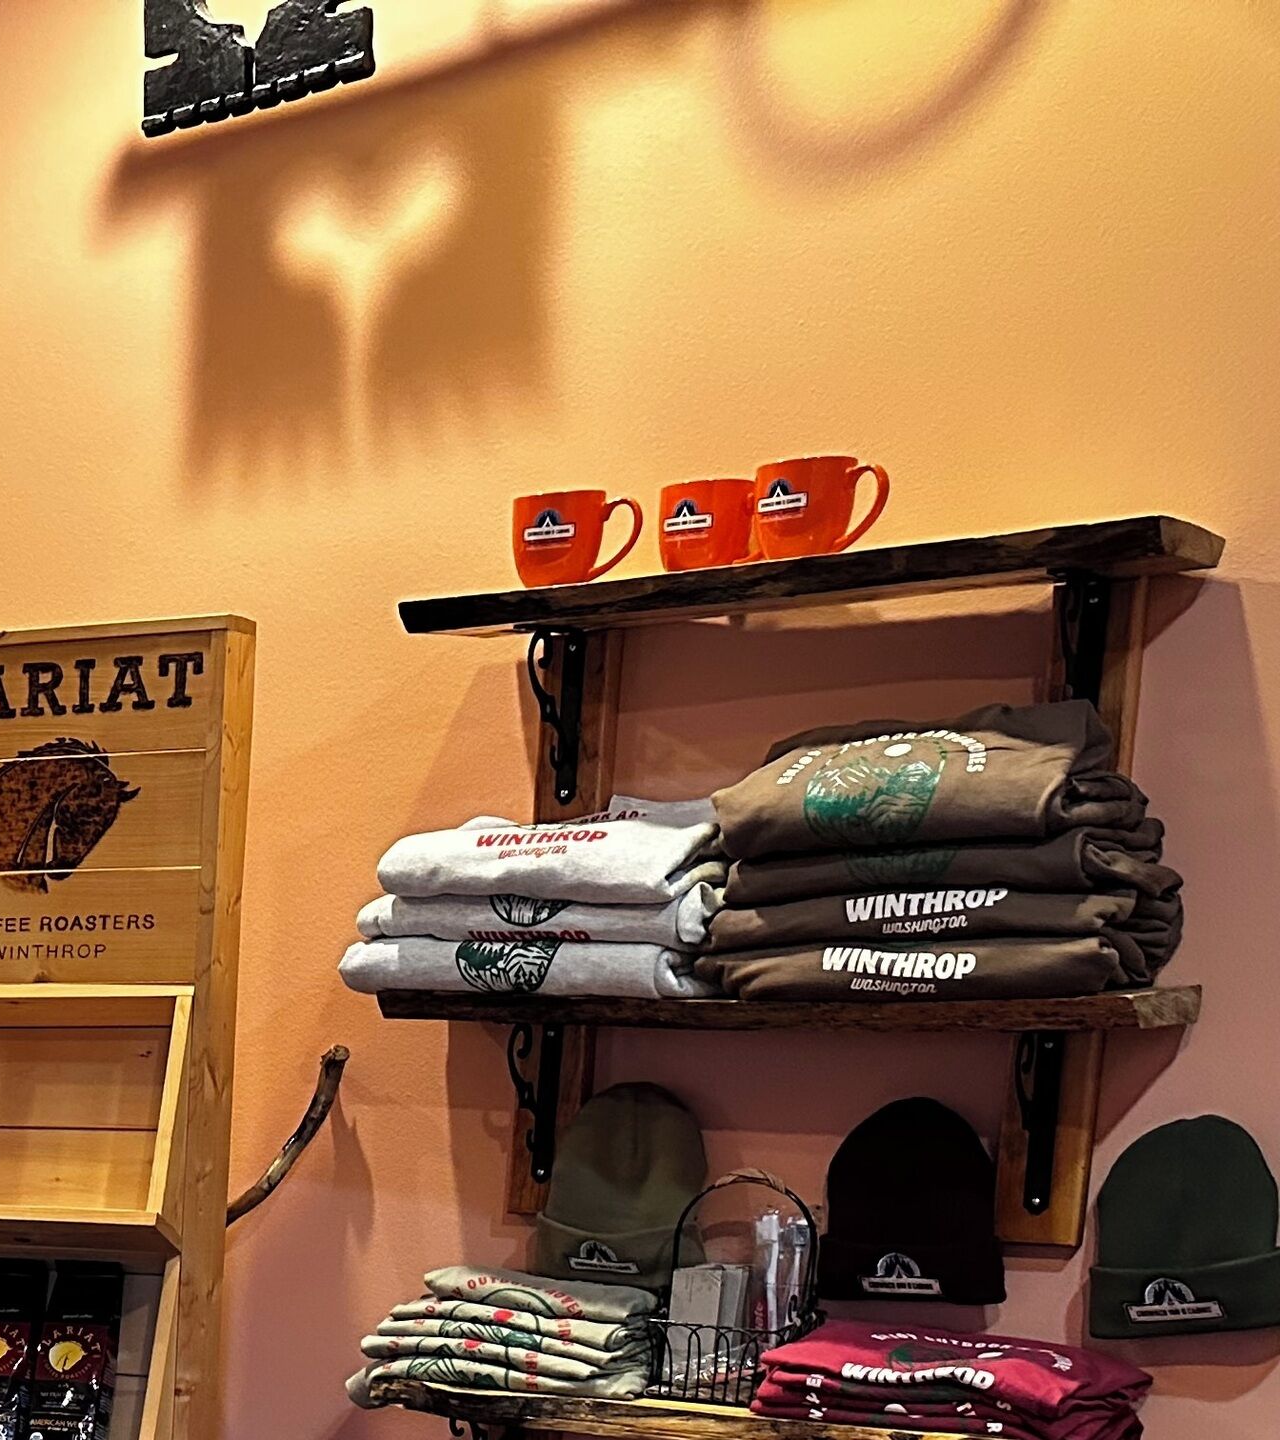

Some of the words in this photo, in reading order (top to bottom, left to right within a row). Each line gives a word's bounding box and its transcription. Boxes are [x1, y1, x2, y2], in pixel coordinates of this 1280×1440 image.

[476, 830, 608, 848] WINTHROP
[845, 888, 1009, 923] WINTHROP
[39, 914, 156, 933] ROASTERS
[822, 946, 977, 980] WINTHROP
[41, 1326, 102, 1351] LARIAT
